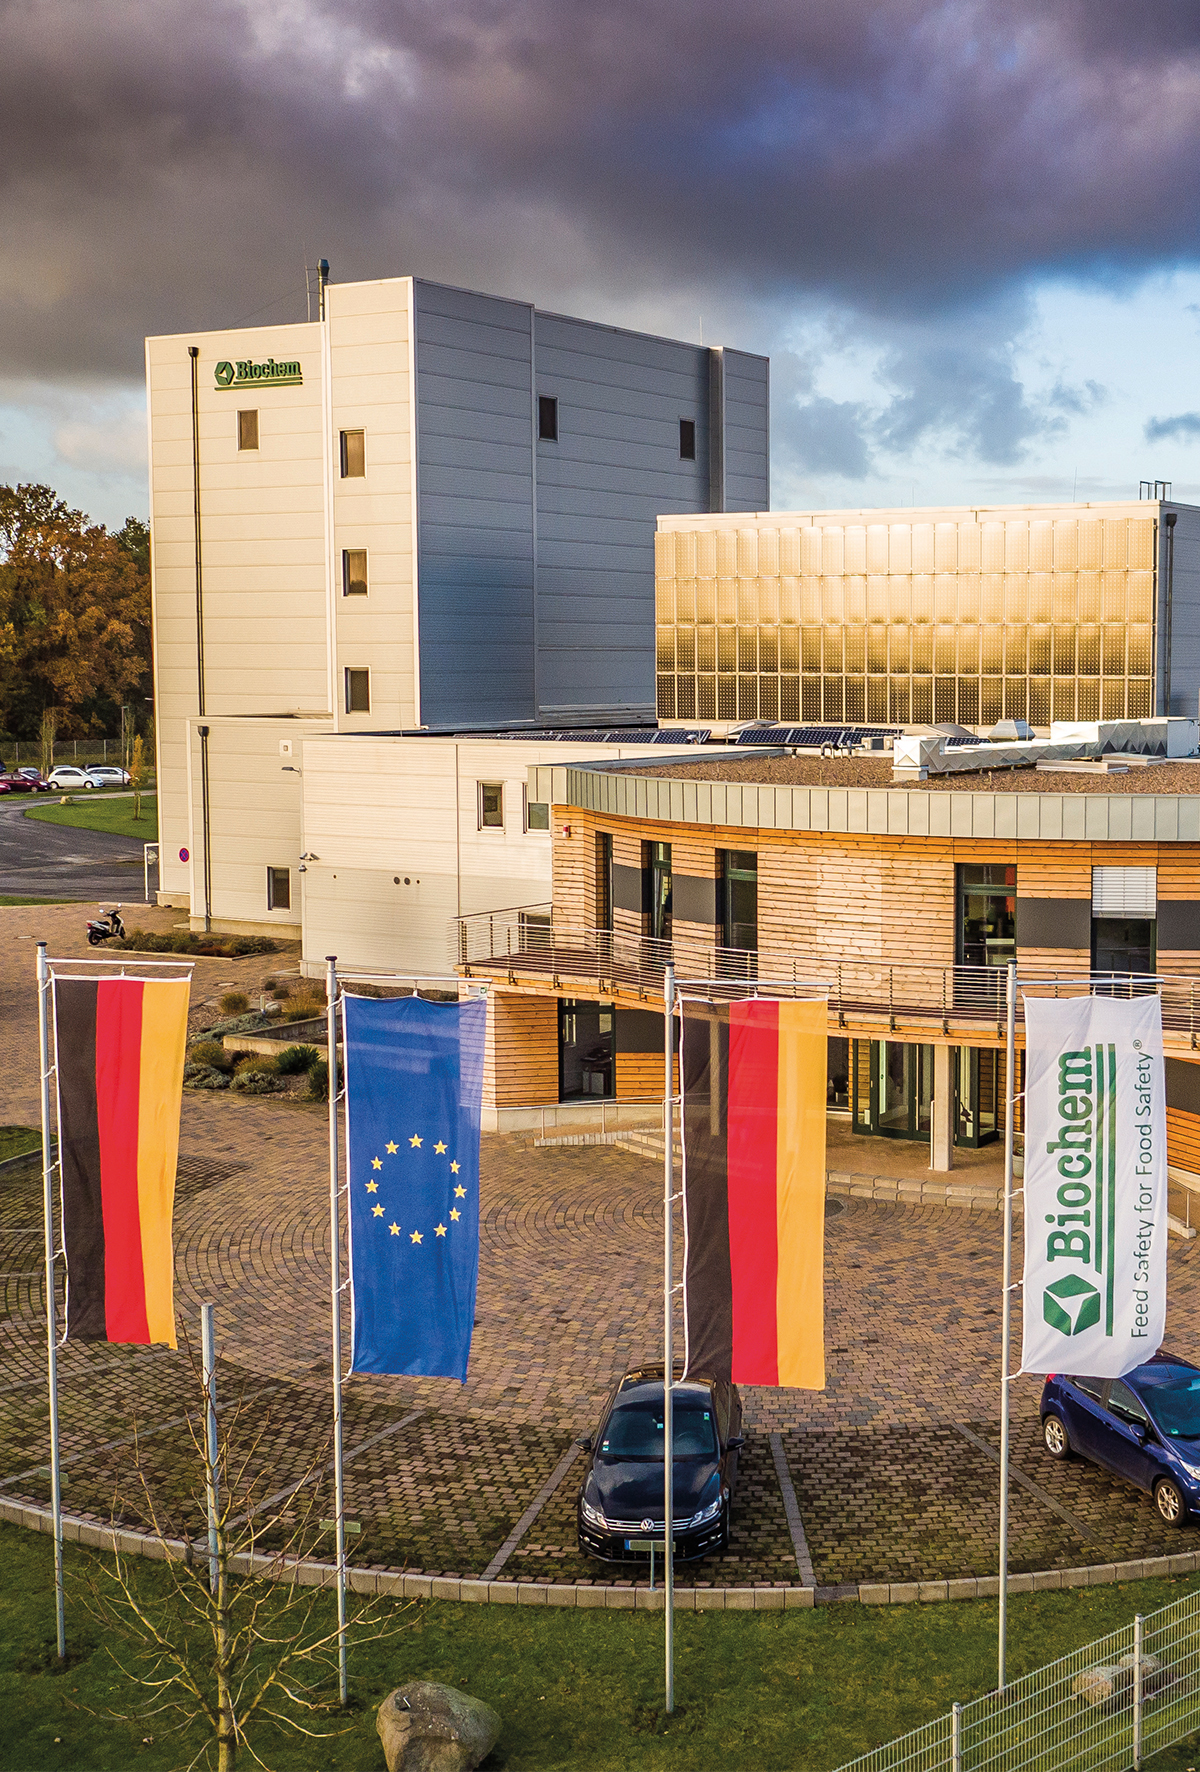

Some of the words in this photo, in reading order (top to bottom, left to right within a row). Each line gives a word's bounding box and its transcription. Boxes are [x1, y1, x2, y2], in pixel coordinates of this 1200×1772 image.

[235, 358, 302, 380] Biochem
[1045, 1046, 1093, 1265] Biochem
[1134, 1124, 1153, 1175] Food
[1134, 1183, 1153, 1213] for
[1133, 1219, 1156, 1283] Safety
[1131, 1289, 1149, 1338] Feed
